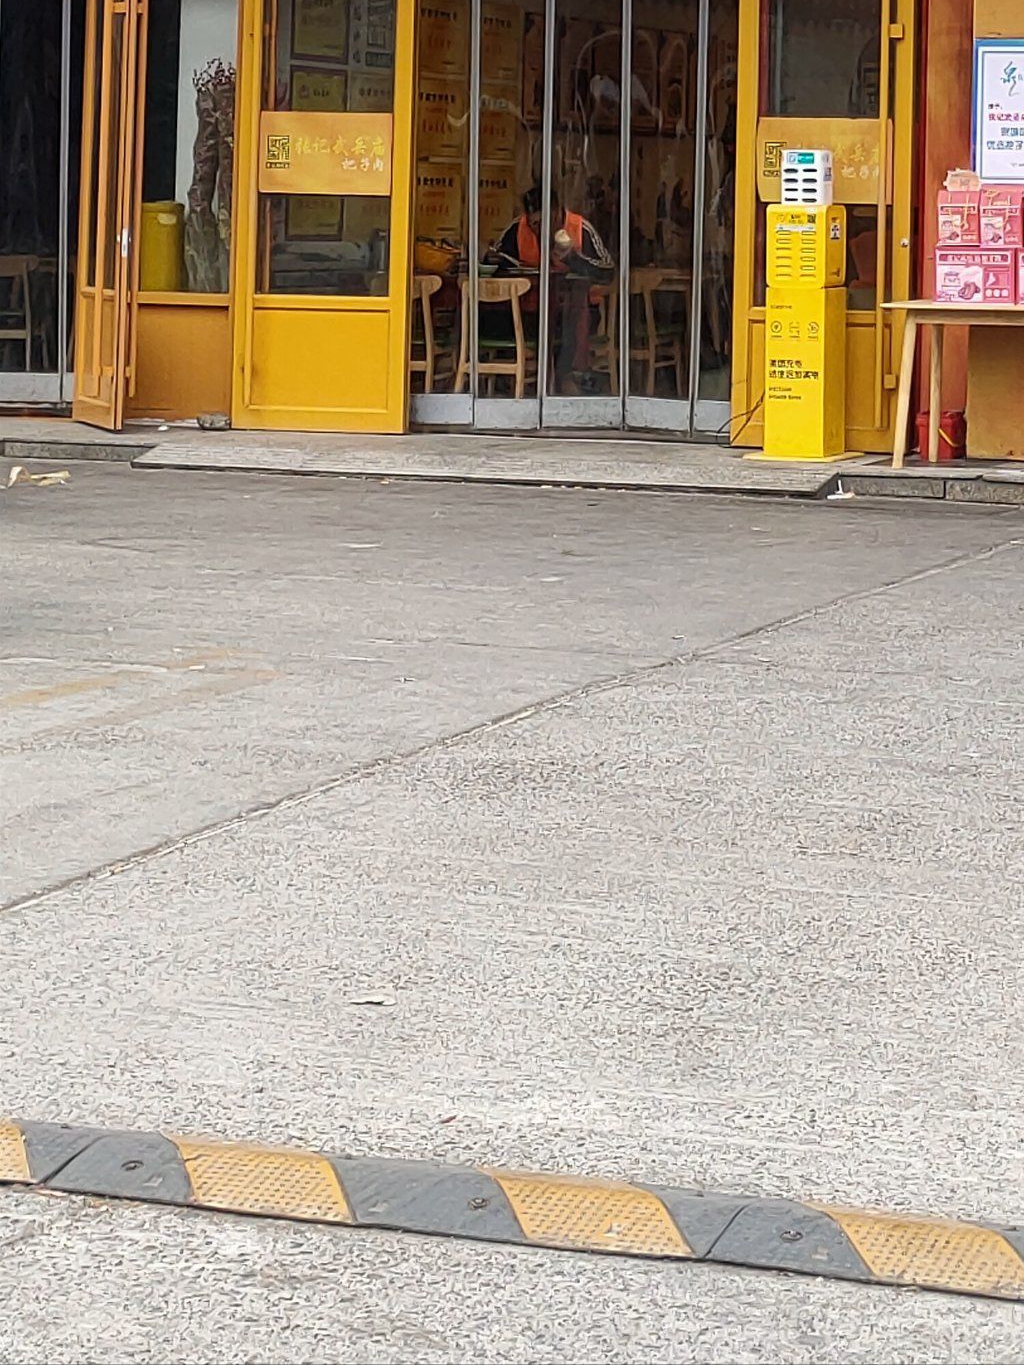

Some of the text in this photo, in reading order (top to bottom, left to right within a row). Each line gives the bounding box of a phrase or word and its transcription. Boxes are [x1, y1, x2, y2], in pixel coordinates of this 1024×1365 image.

[295, 135, 385, 157] 张记武岳庙
[341, 158, 384, 171] 把子肉
